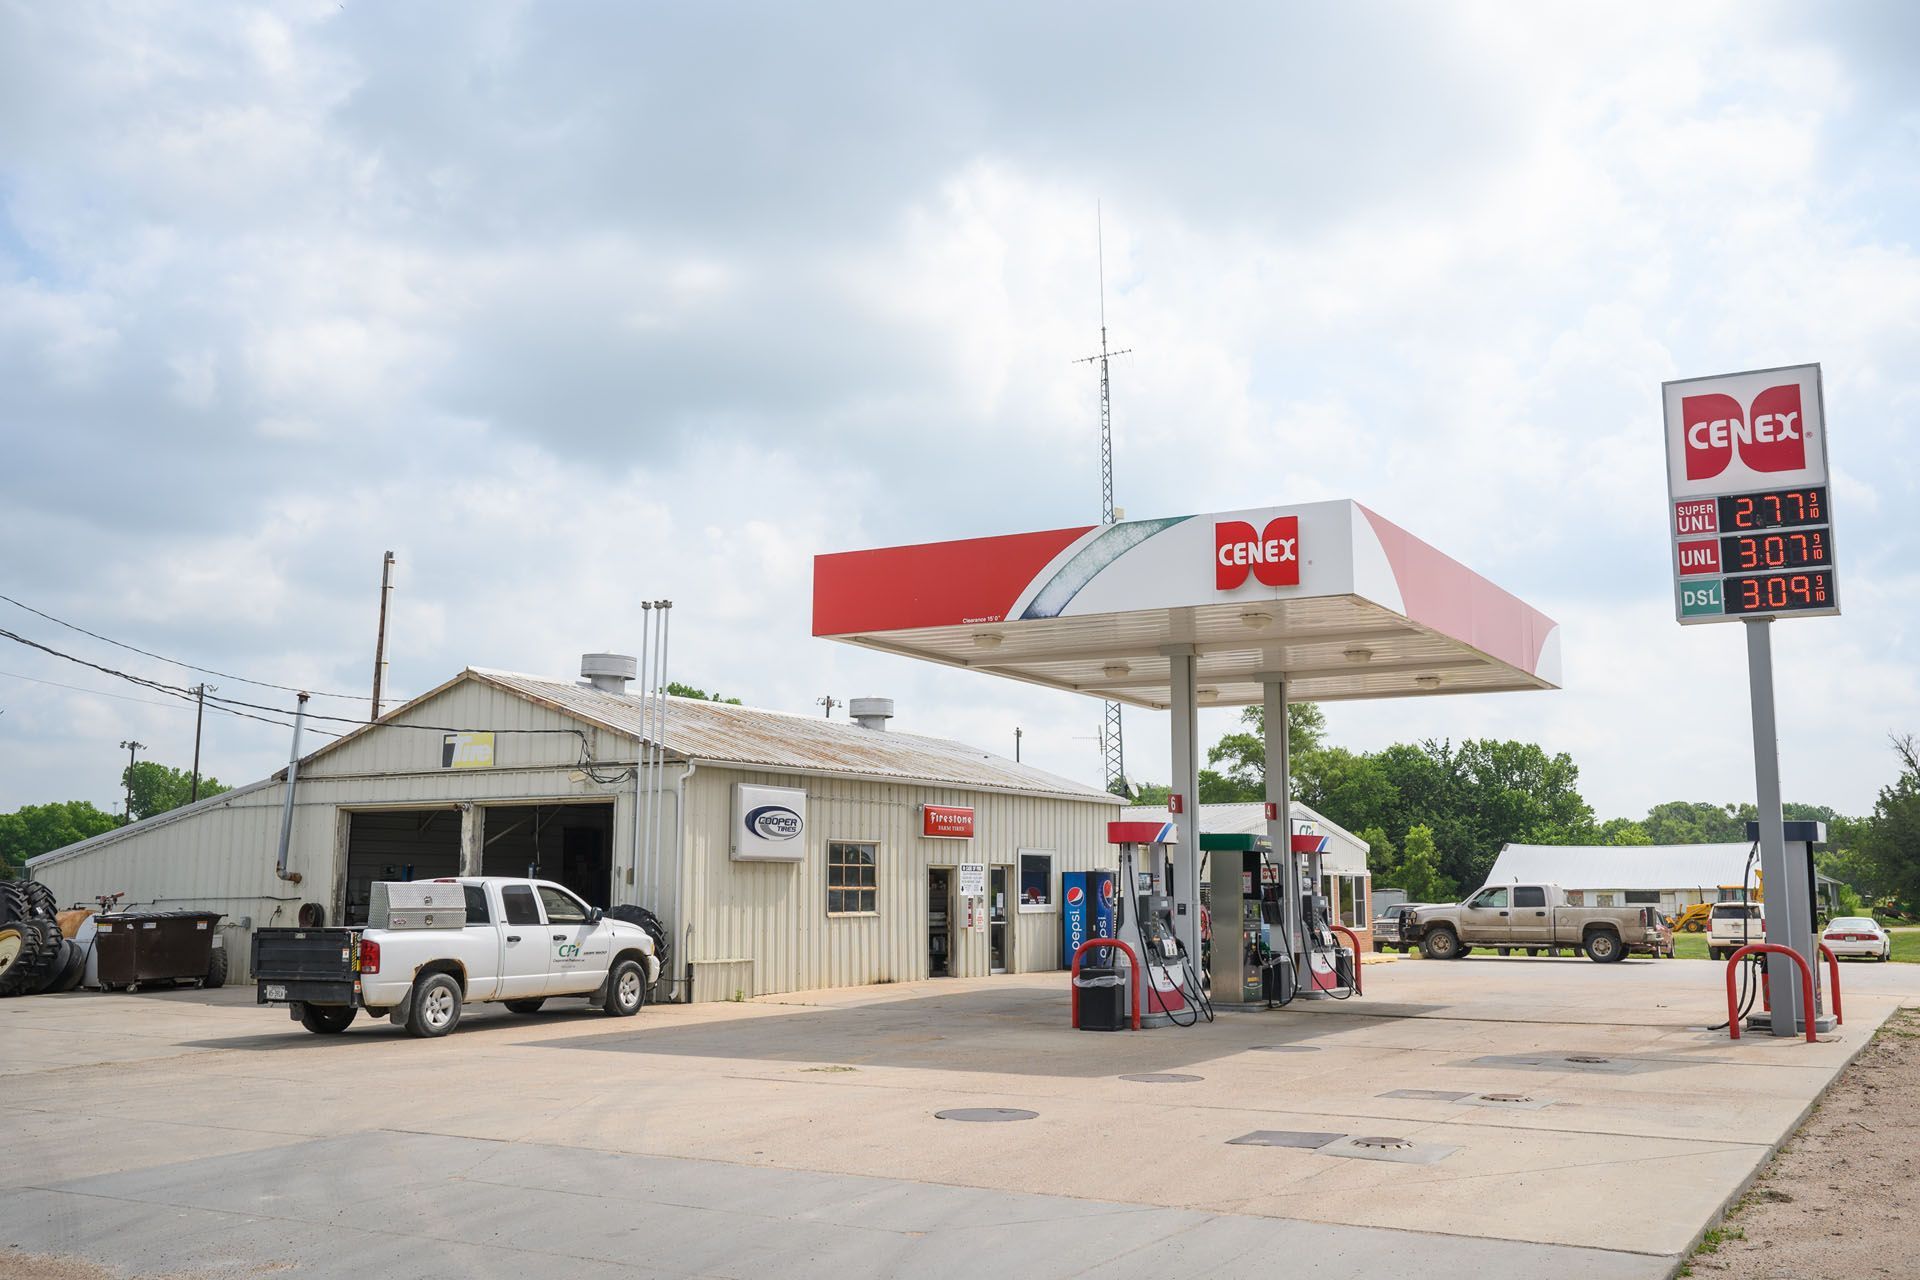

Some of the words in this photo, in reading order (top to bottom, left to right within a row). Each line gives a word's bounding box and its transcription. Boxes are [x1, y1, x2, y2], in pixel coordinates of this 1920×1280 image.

[1687, 413, 1800, 450] CENEX
[1809, 492, 1817, 502] 9
[1678, 503, 1714, 516] SUPER
[1678, 515, 1715, 533] UNL
[1813, 533, 1820, 544] 9
[1218, 538, 1296, 567] CENEX
[1681, 549, 1717, 567] UNL
[1740, 534, 1808, 568] 3.07
[1815, 575, 1823, 586] 9
[1683, 587, 1720, 607] DSL
[1742, 575, 1811, 609] 3.09
[445, 735, 491, 763] Tire
[1170, 796, 1176, 811] 6
[1266, 805, 1271, 817] 4
[758, 816, 798, 827] COOPER
[930, 811, 973, 825] Firestone
[777, 825, 797, 833] TIRES
